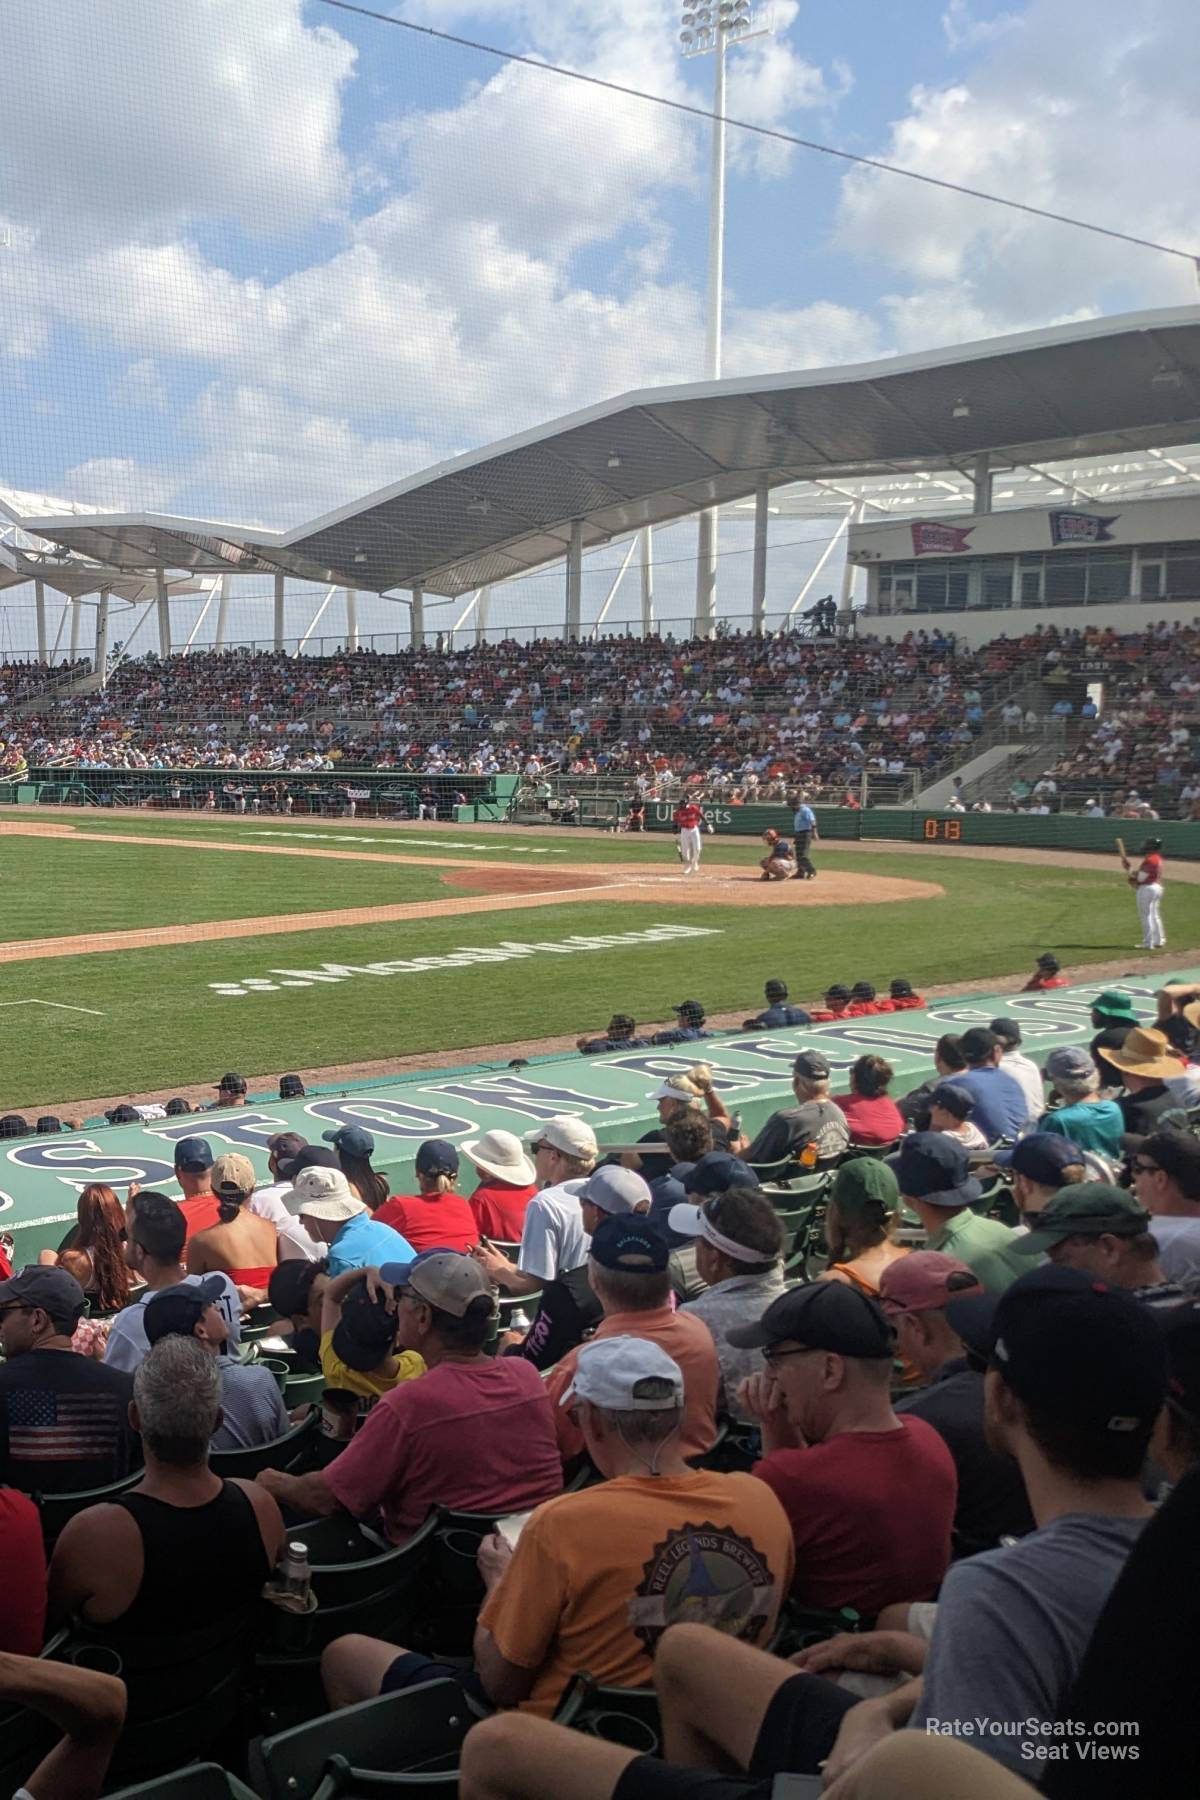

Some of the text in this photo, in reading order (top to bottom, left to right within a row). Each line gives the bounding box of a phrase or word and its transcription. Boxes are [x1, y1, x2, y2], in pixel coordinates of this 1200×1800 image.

[270, 924, 725, 983] MassMutual
[652, 1561, 672, 1591] REEL
[670, 1536, 719, 1561] LEGNDS
